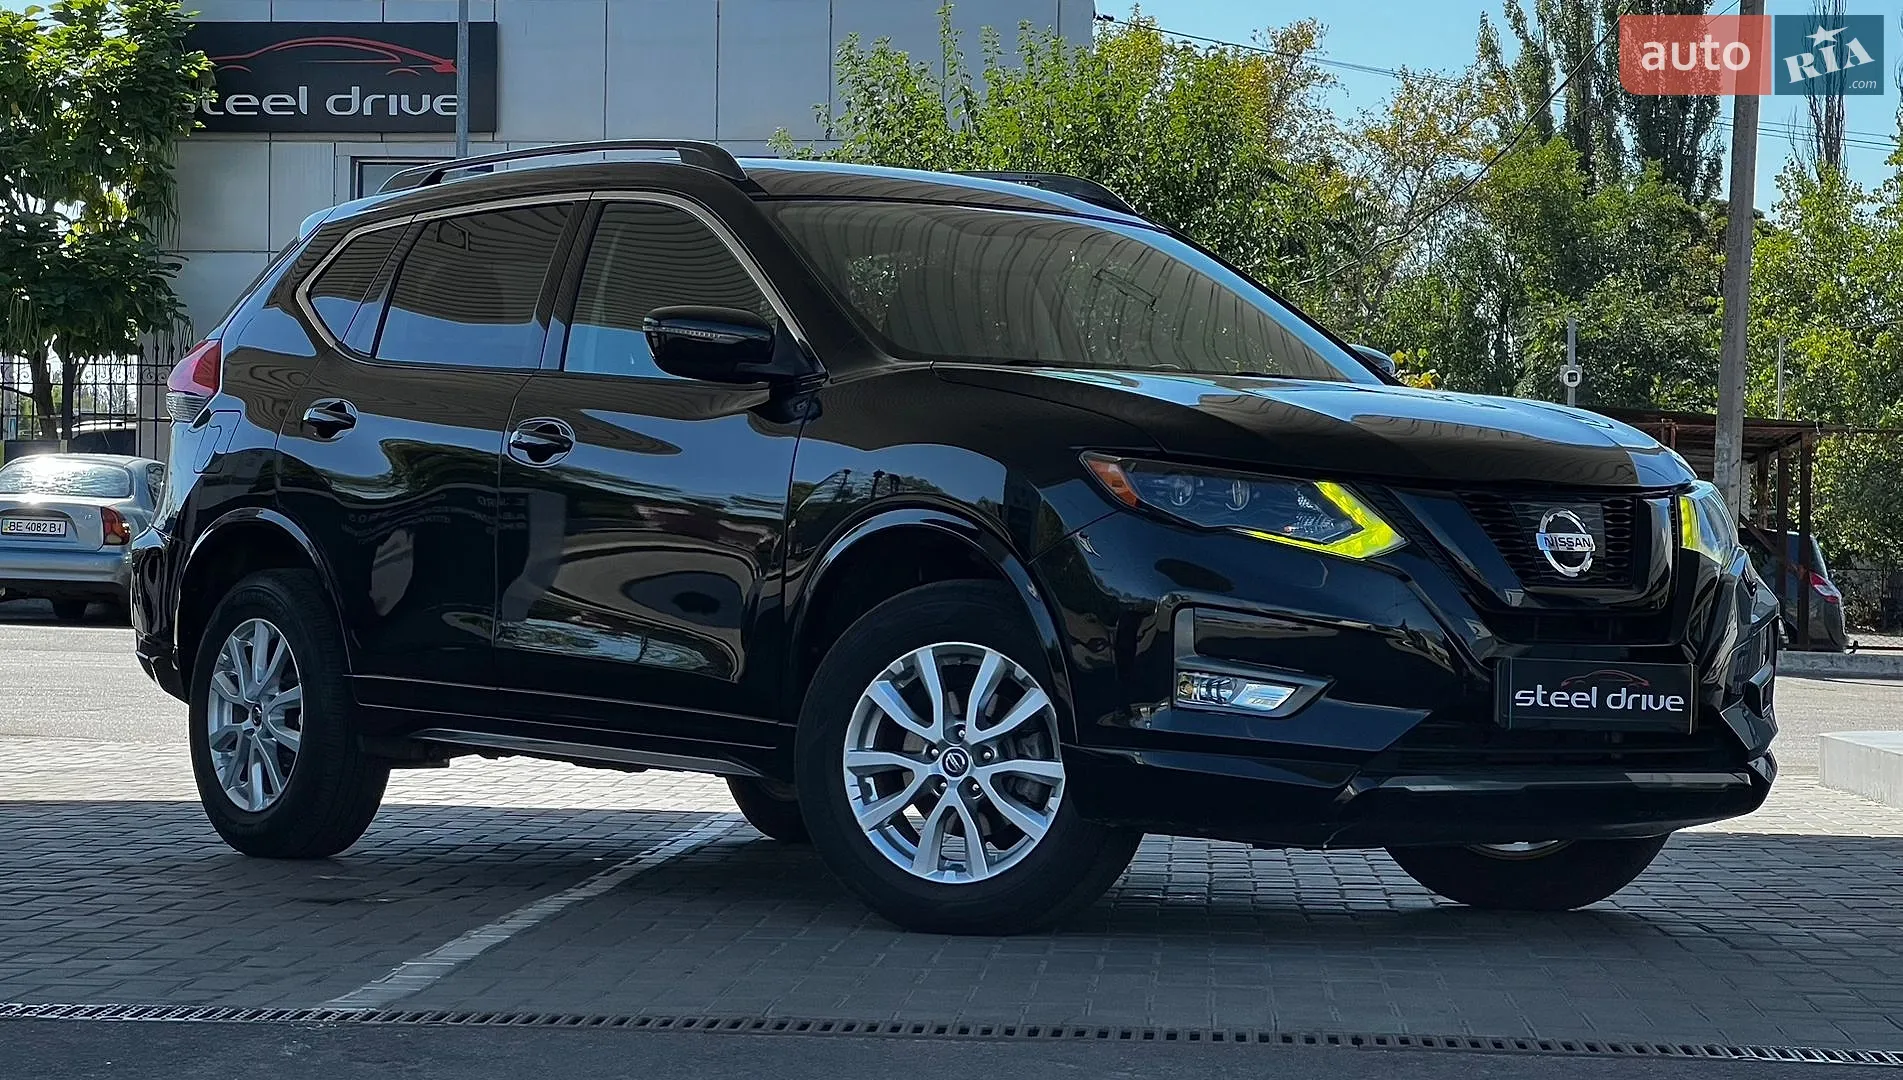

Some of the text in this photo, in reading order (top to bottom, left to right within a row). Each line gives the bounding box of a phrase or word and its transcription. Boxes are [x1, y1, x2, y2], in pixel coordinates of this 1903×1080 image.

[325, 86, 457, 116] drive
[9, 521, 23, 531] BE
[25, 522, 48, 532] 4082
[1543, 536, 1591, 549] NISSAN
[1515, 684, 1684, 712] steel drive
